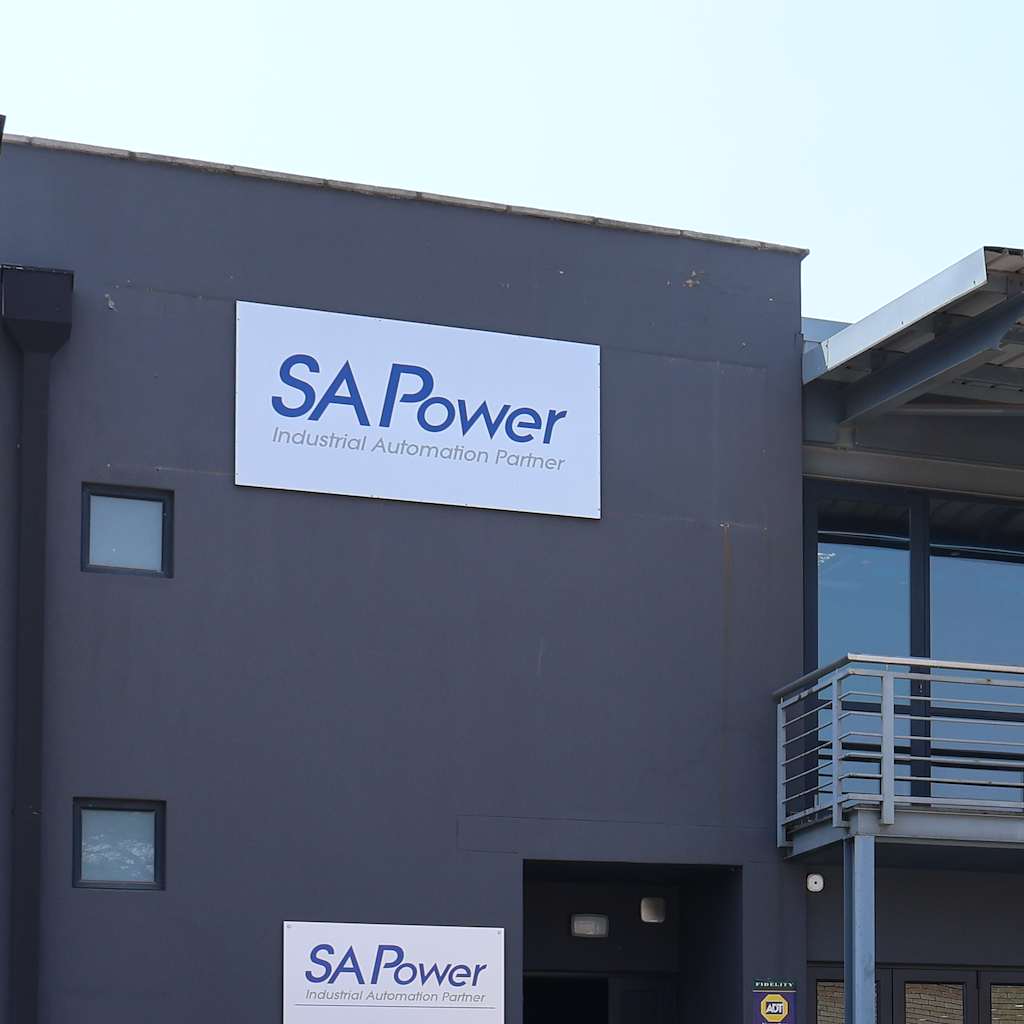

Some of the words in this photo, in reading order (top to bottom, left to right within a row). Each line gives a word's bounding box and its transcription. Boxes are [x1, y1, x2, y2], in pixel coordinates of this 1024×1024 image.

[271, 426, 367, 452] Industrial
[371, 437, 489, 464] Automation
[495, 449, 566, 472] Partner
[305, 989, 363, 1001] Industrial
[367, 990, 438, 1002] Automation
[442, 992, 486, 1003] Partner
[766, 1002, 784, 1014] ADT
